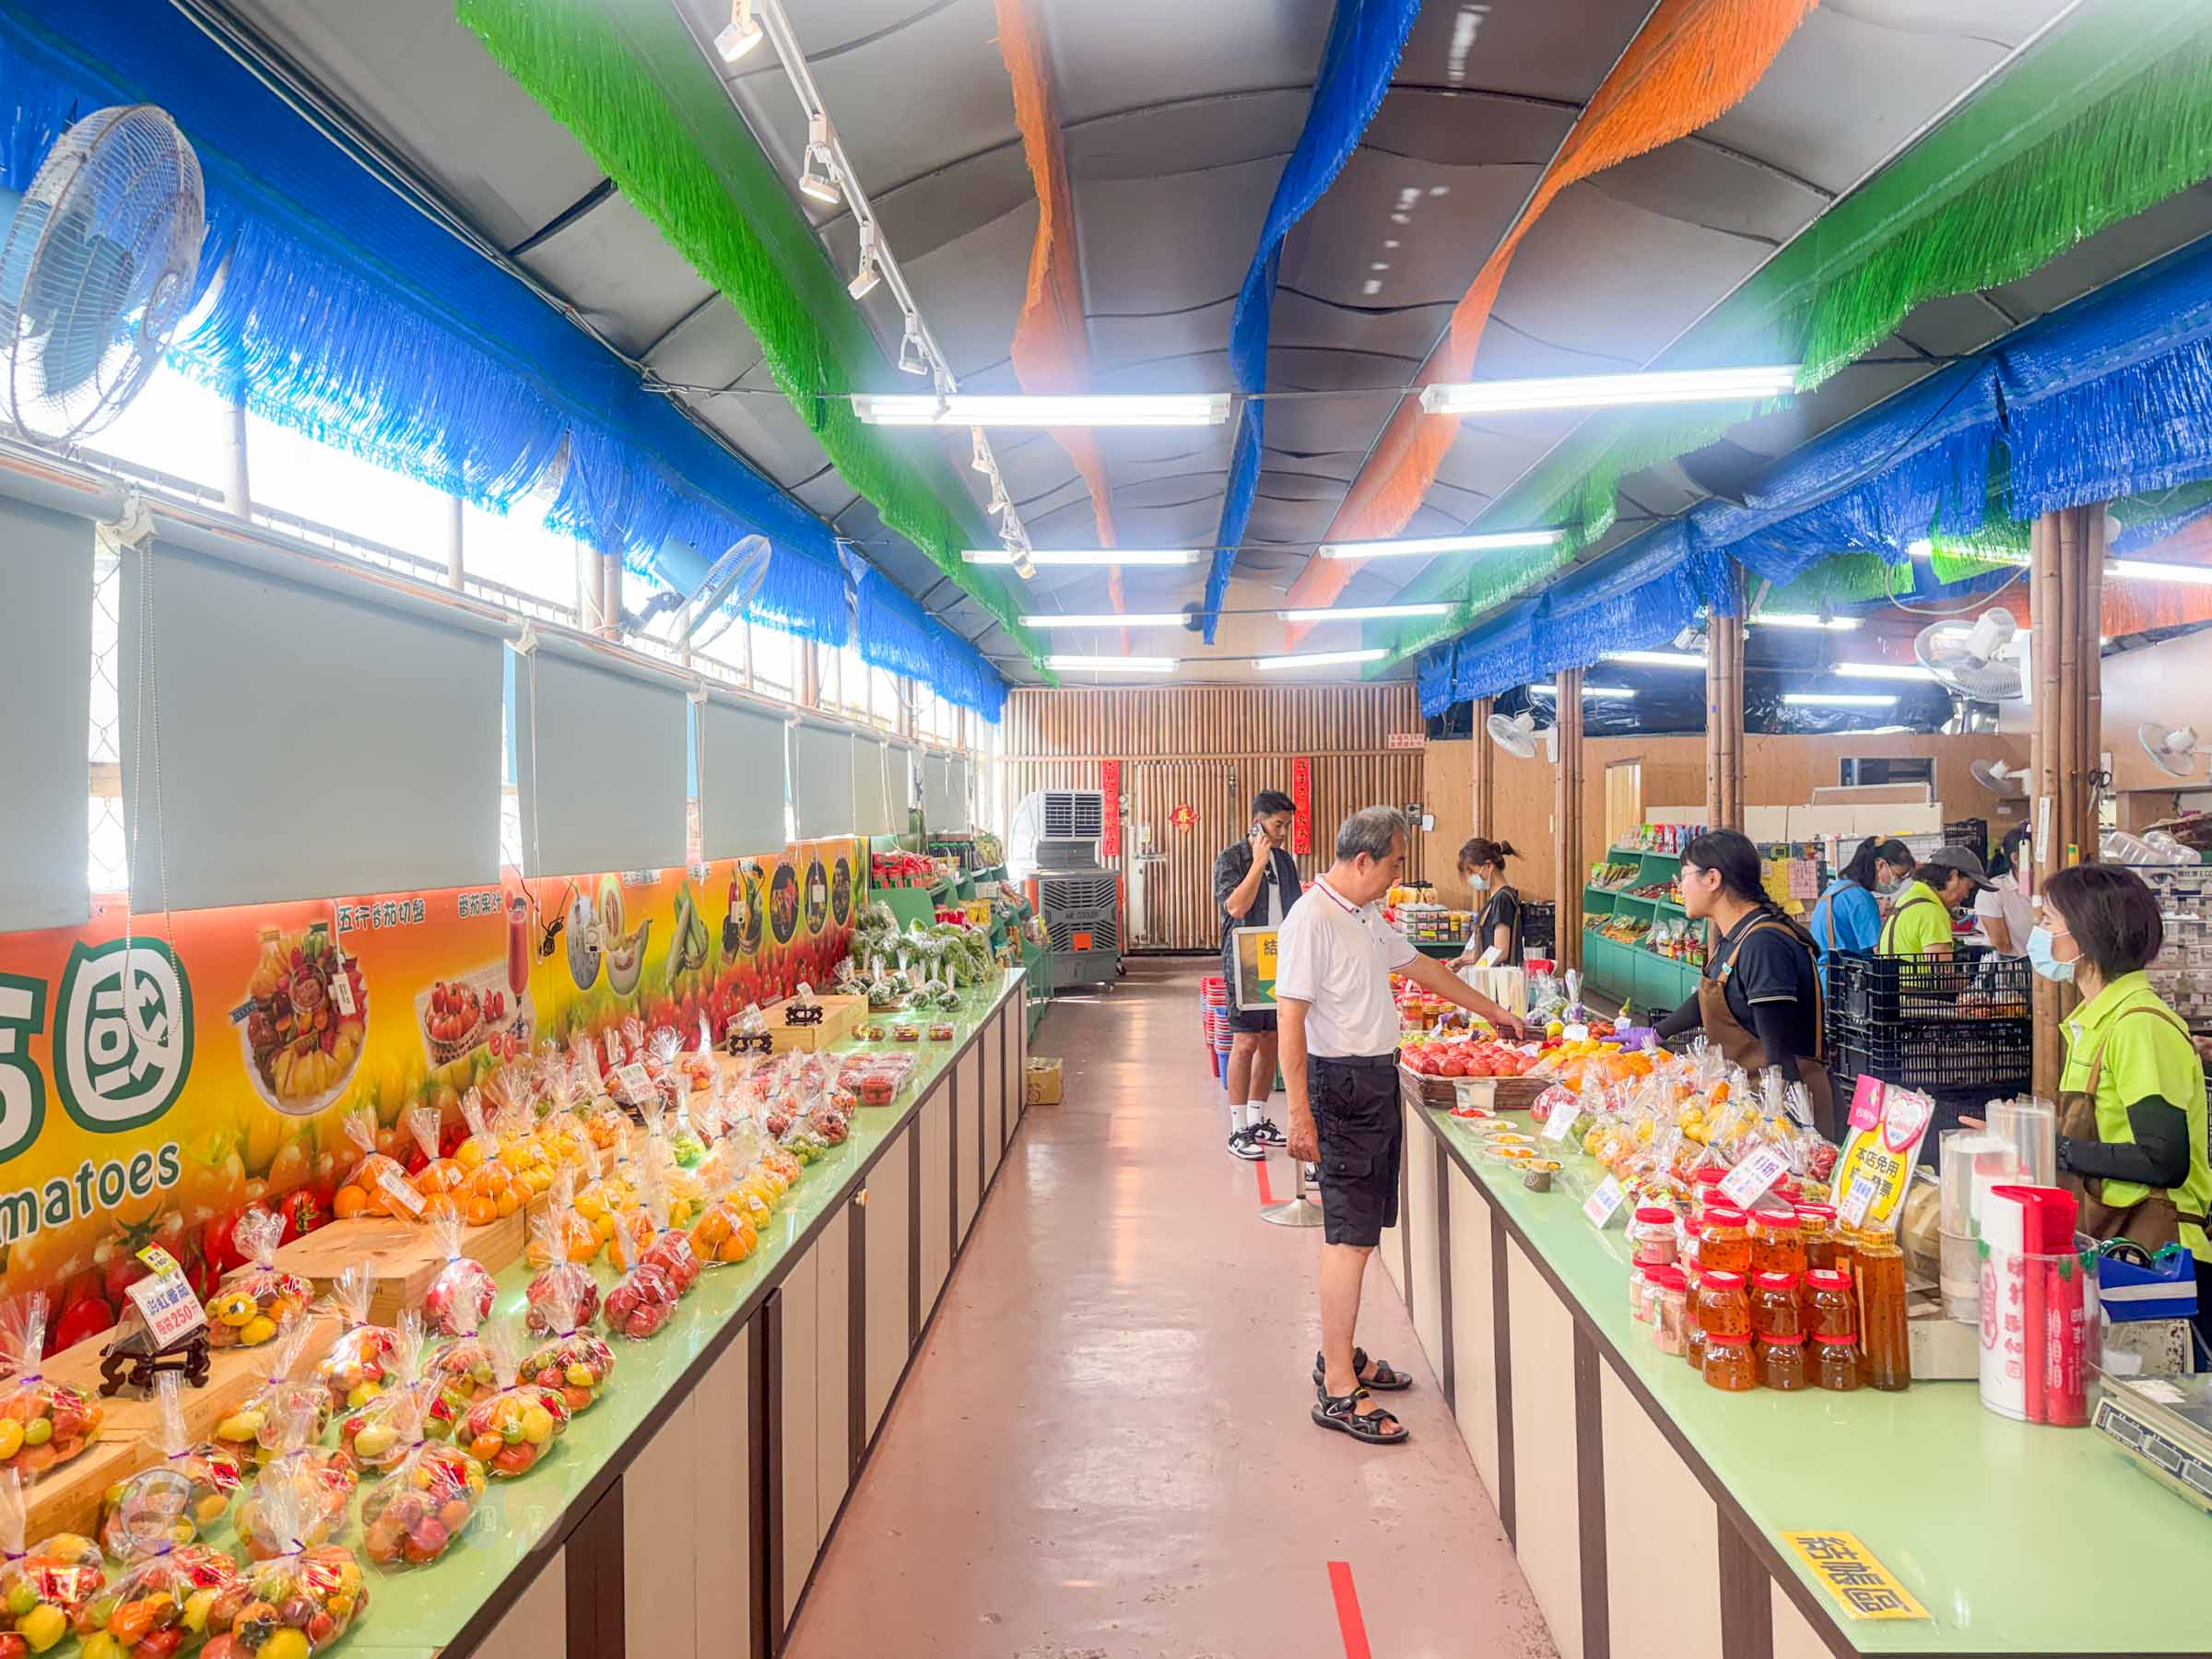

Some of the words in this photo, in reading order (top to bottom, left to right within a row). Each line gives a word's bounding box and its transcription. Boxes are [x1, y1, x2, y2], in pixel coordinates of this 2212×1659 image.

[338, 899, 424, 933] 五行番茄切盤
[457, 891, 502, 918] 番茄果汁
[1856, 1147, 1900, 1179] 本店免用
[1795, 1536, 1912, 1613] 結帳區
